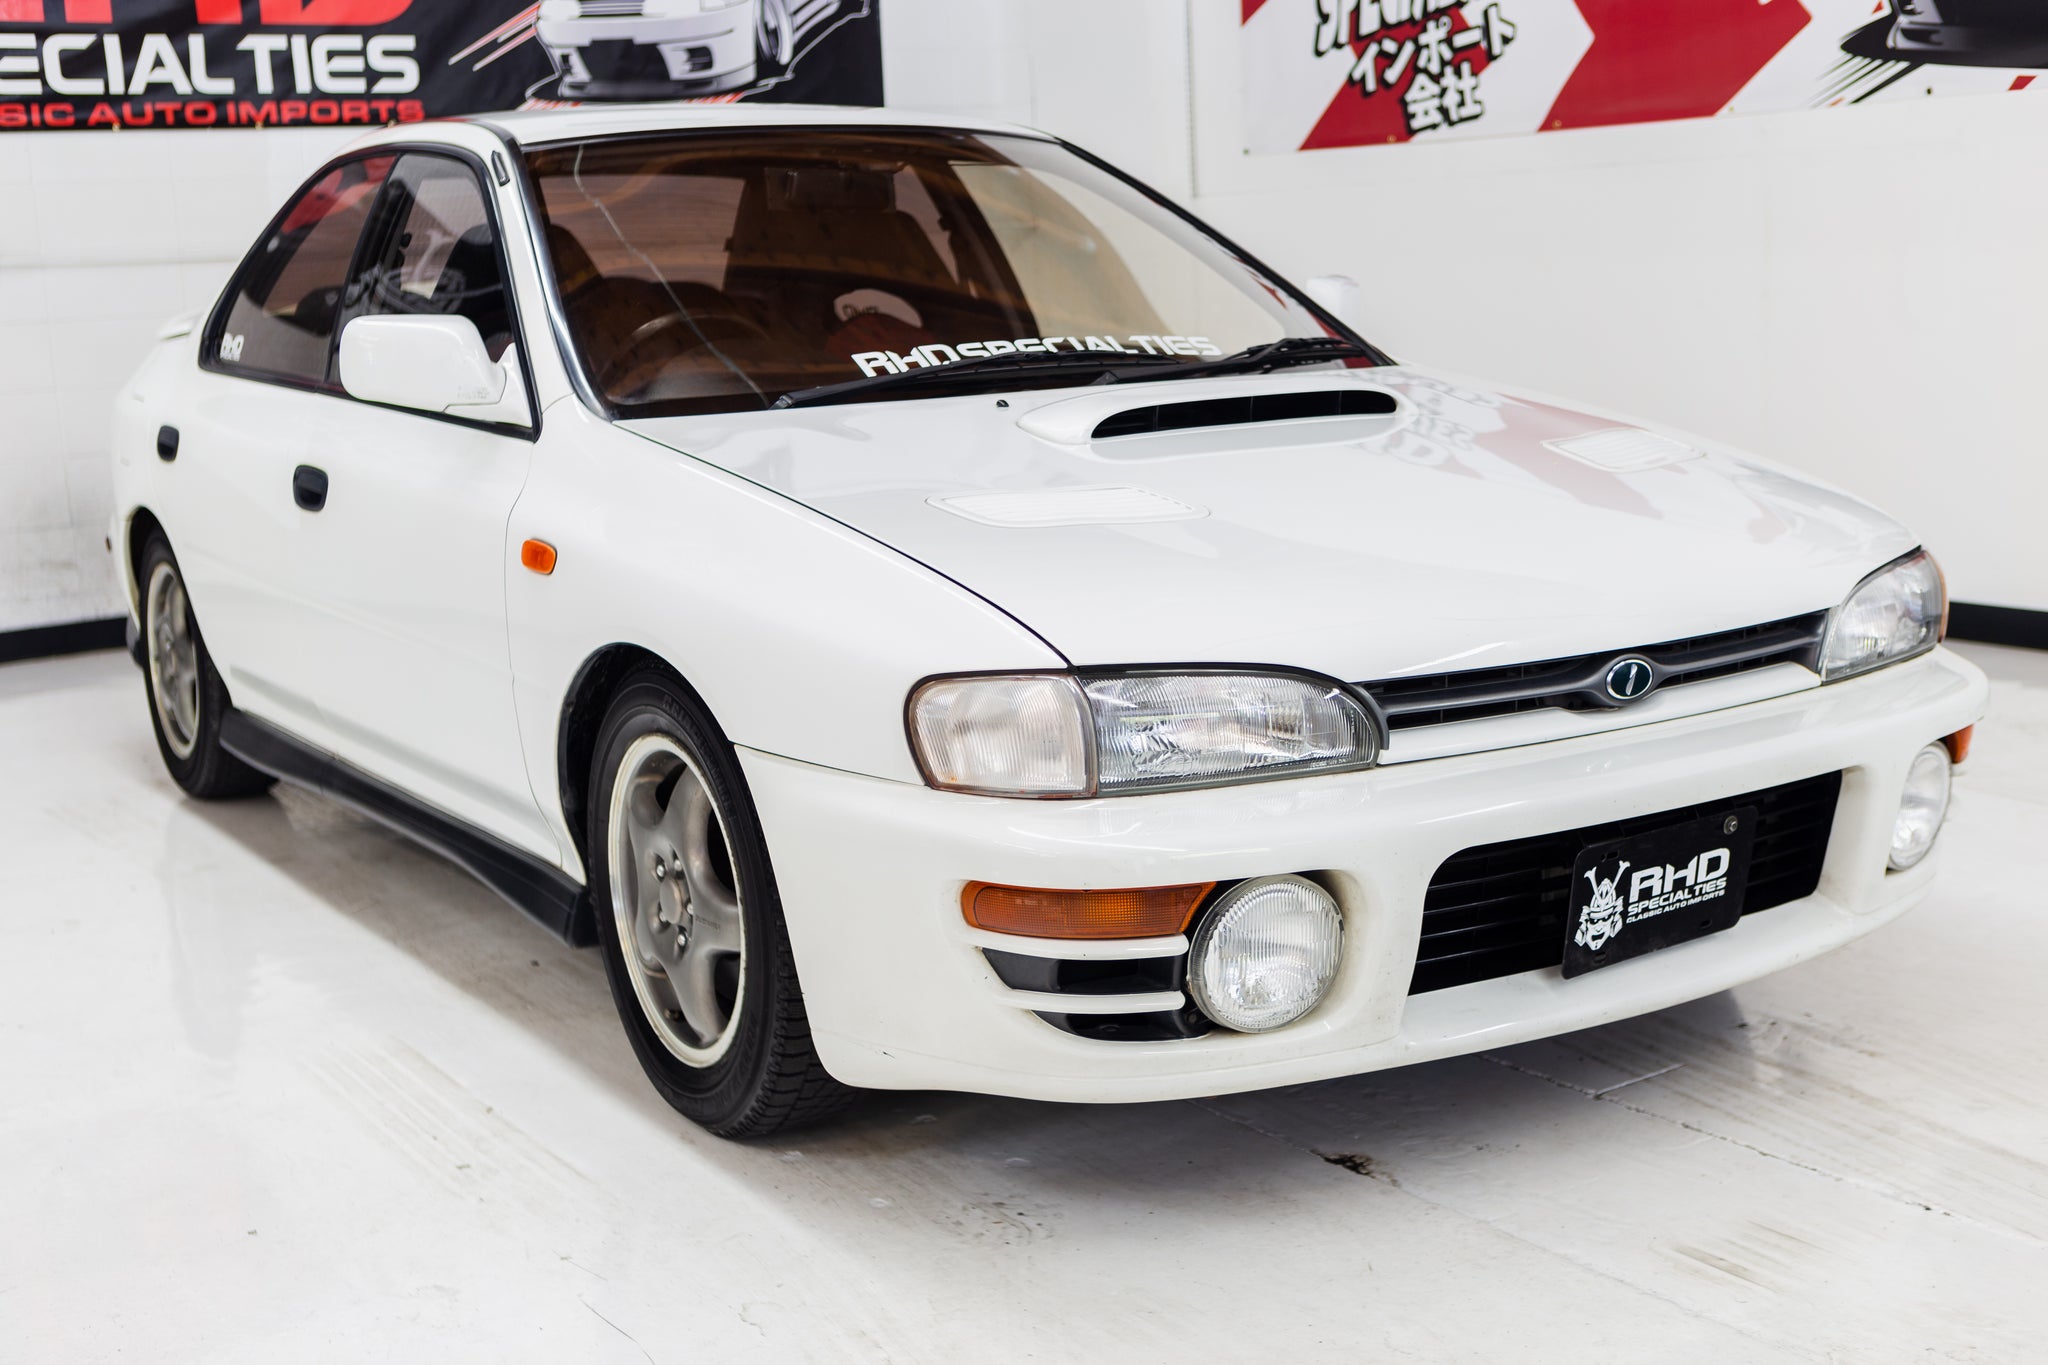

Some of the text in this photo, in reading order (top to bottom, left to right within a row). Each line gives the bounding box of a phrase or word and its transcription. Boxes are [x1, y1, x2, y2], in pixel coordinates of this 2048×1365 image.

[1350, 2, 1516, 94] インポート
[87, 101, 217, 126] AUTO
[227, 100, 426, 126] IMPORTS
[1402, 60, 1484, 133] 会社
[851, 343, 961, 378] RHD
[1629, 848, 1731, 904] RHD
[1626, 907, 1663, 924] CLASSIC
[1663, 900, 1688, 913] AUTO
[1627, 877, 1727, 917] SPECIALTIES
